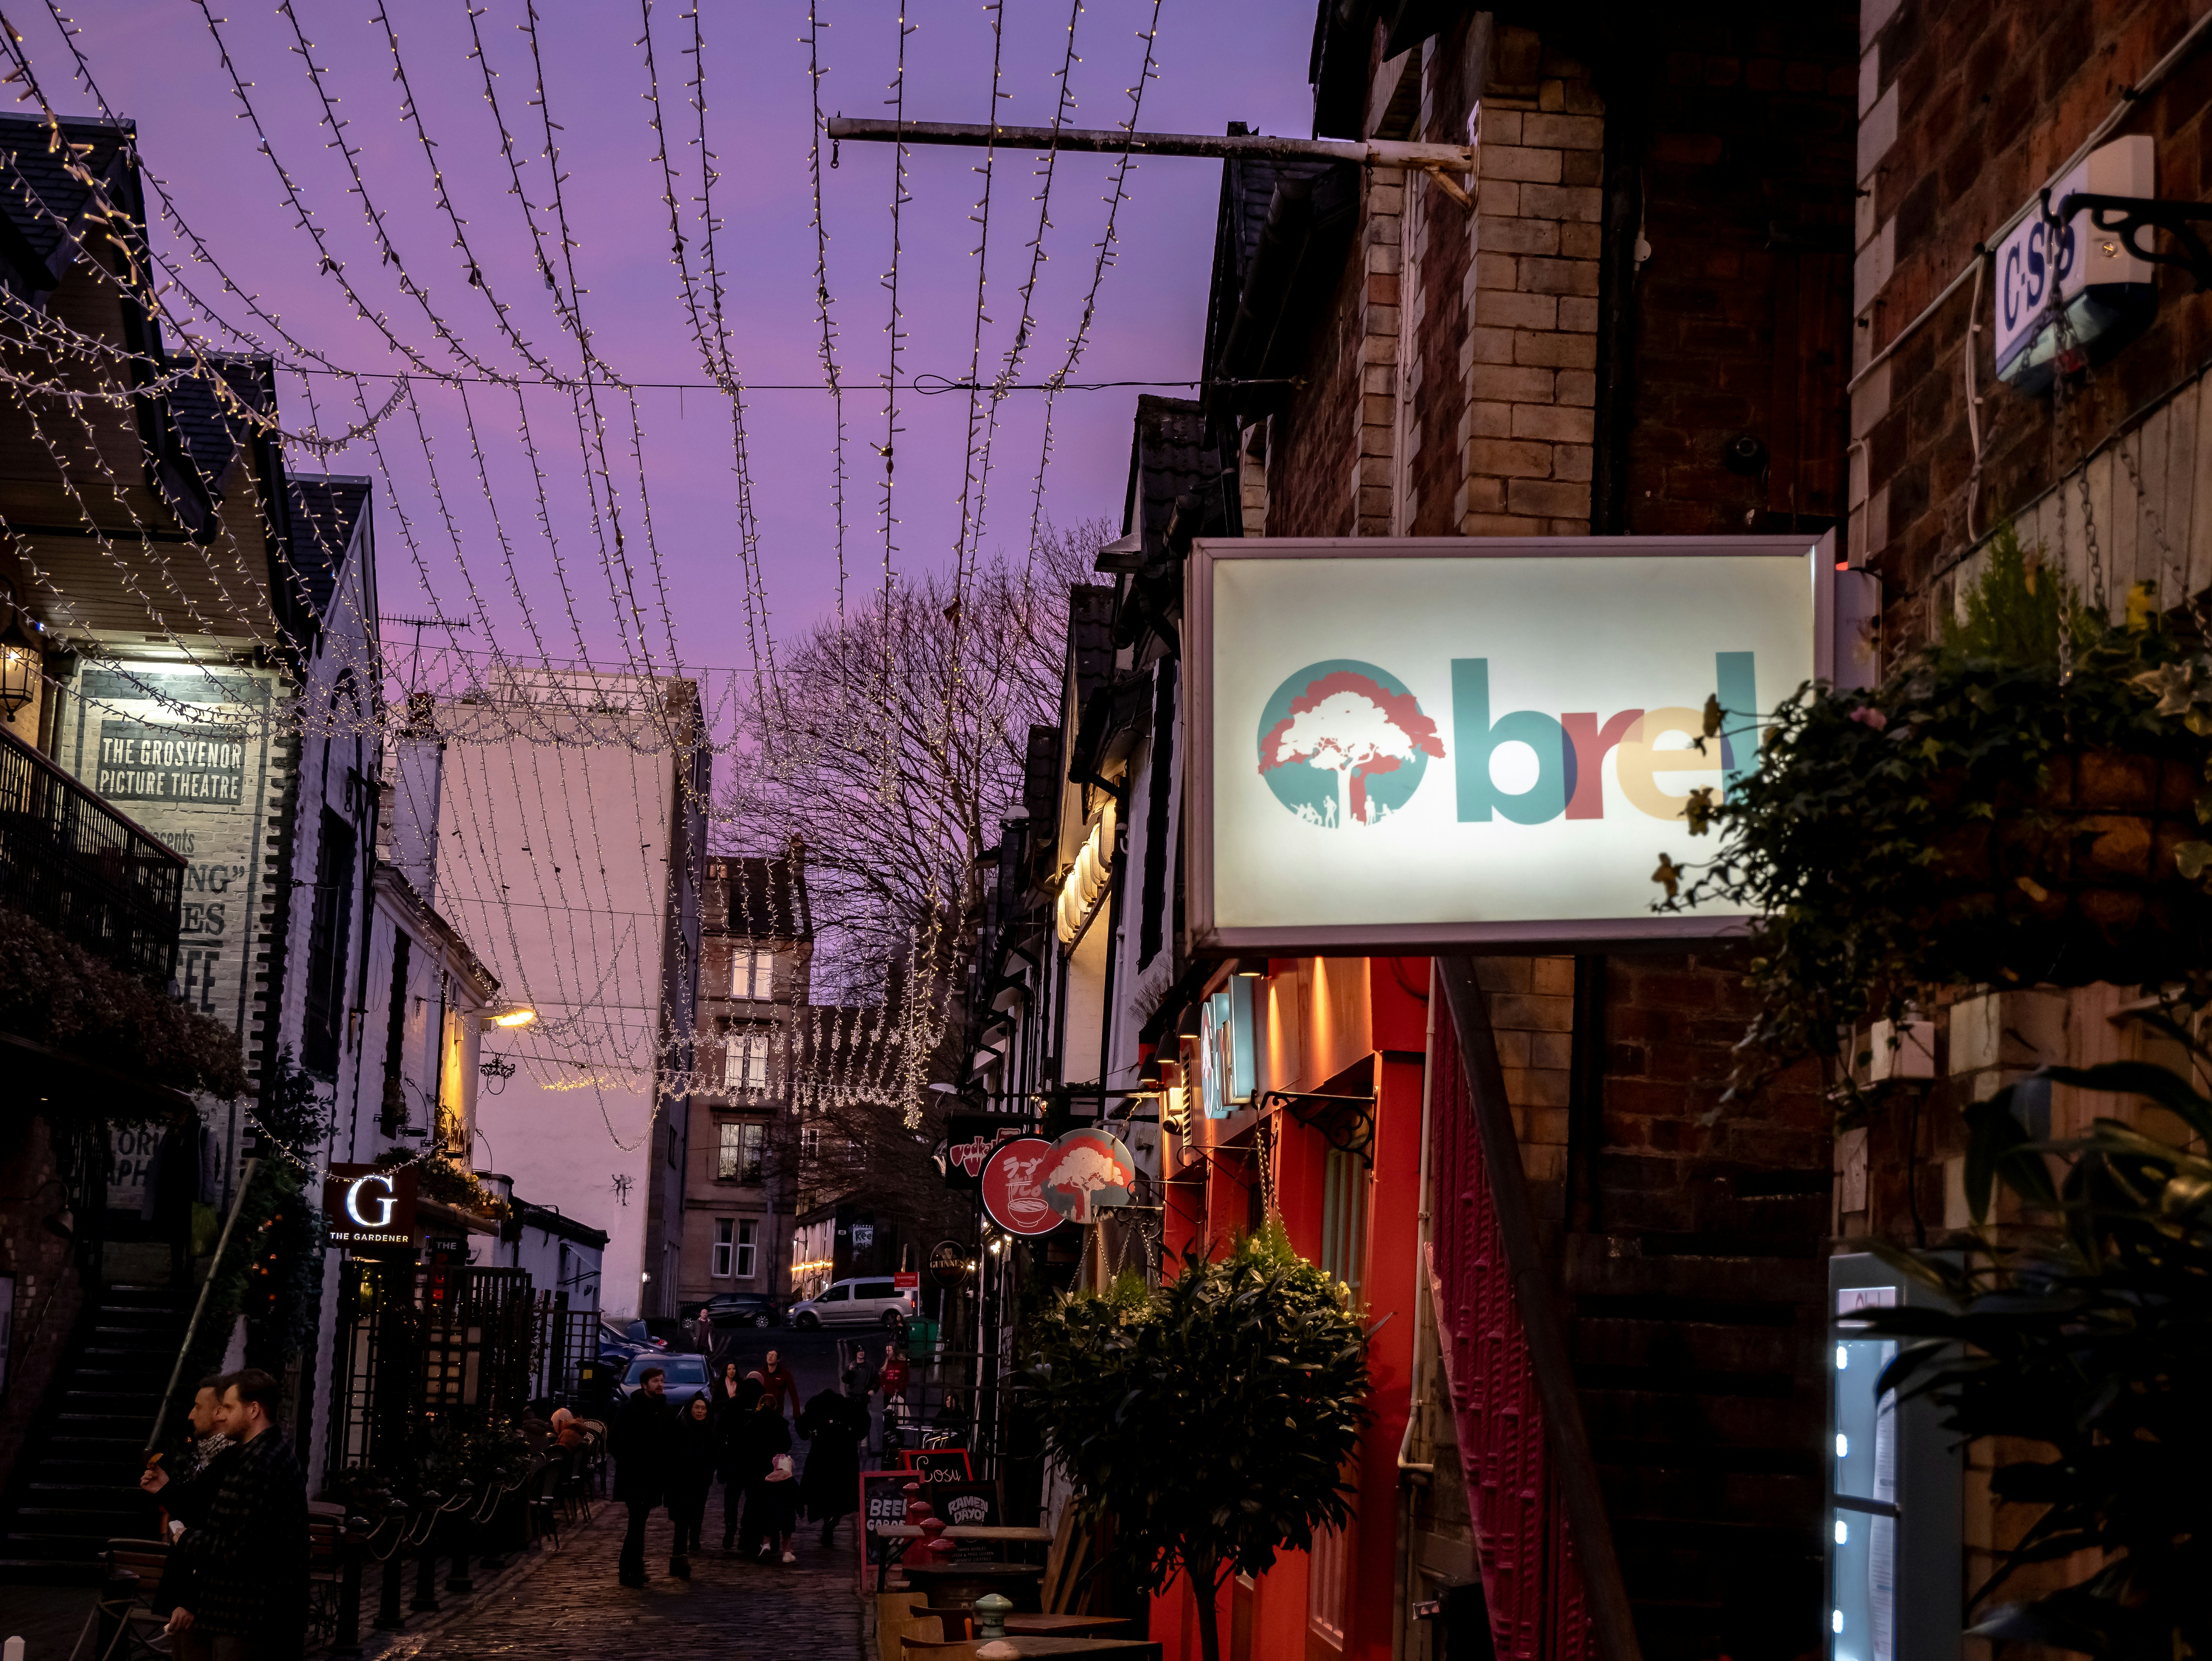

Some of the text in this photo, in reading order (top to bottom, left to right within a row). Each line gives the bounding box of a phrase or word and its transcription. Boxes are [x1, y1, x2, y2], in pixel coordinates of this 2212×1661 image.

[1451, 651, 1759, 825] brel
[103, 738, 242, 768] THE GROSVENOR
[100, 770, 239, 799] PICTURE THEATRE
[345, 1174, 398, 1226] G
[354, 1233, 409, 1242] GARDENER
[436, 1241, 457, 1250] THE
[948, 1496, 988, 1515] RAMEN
